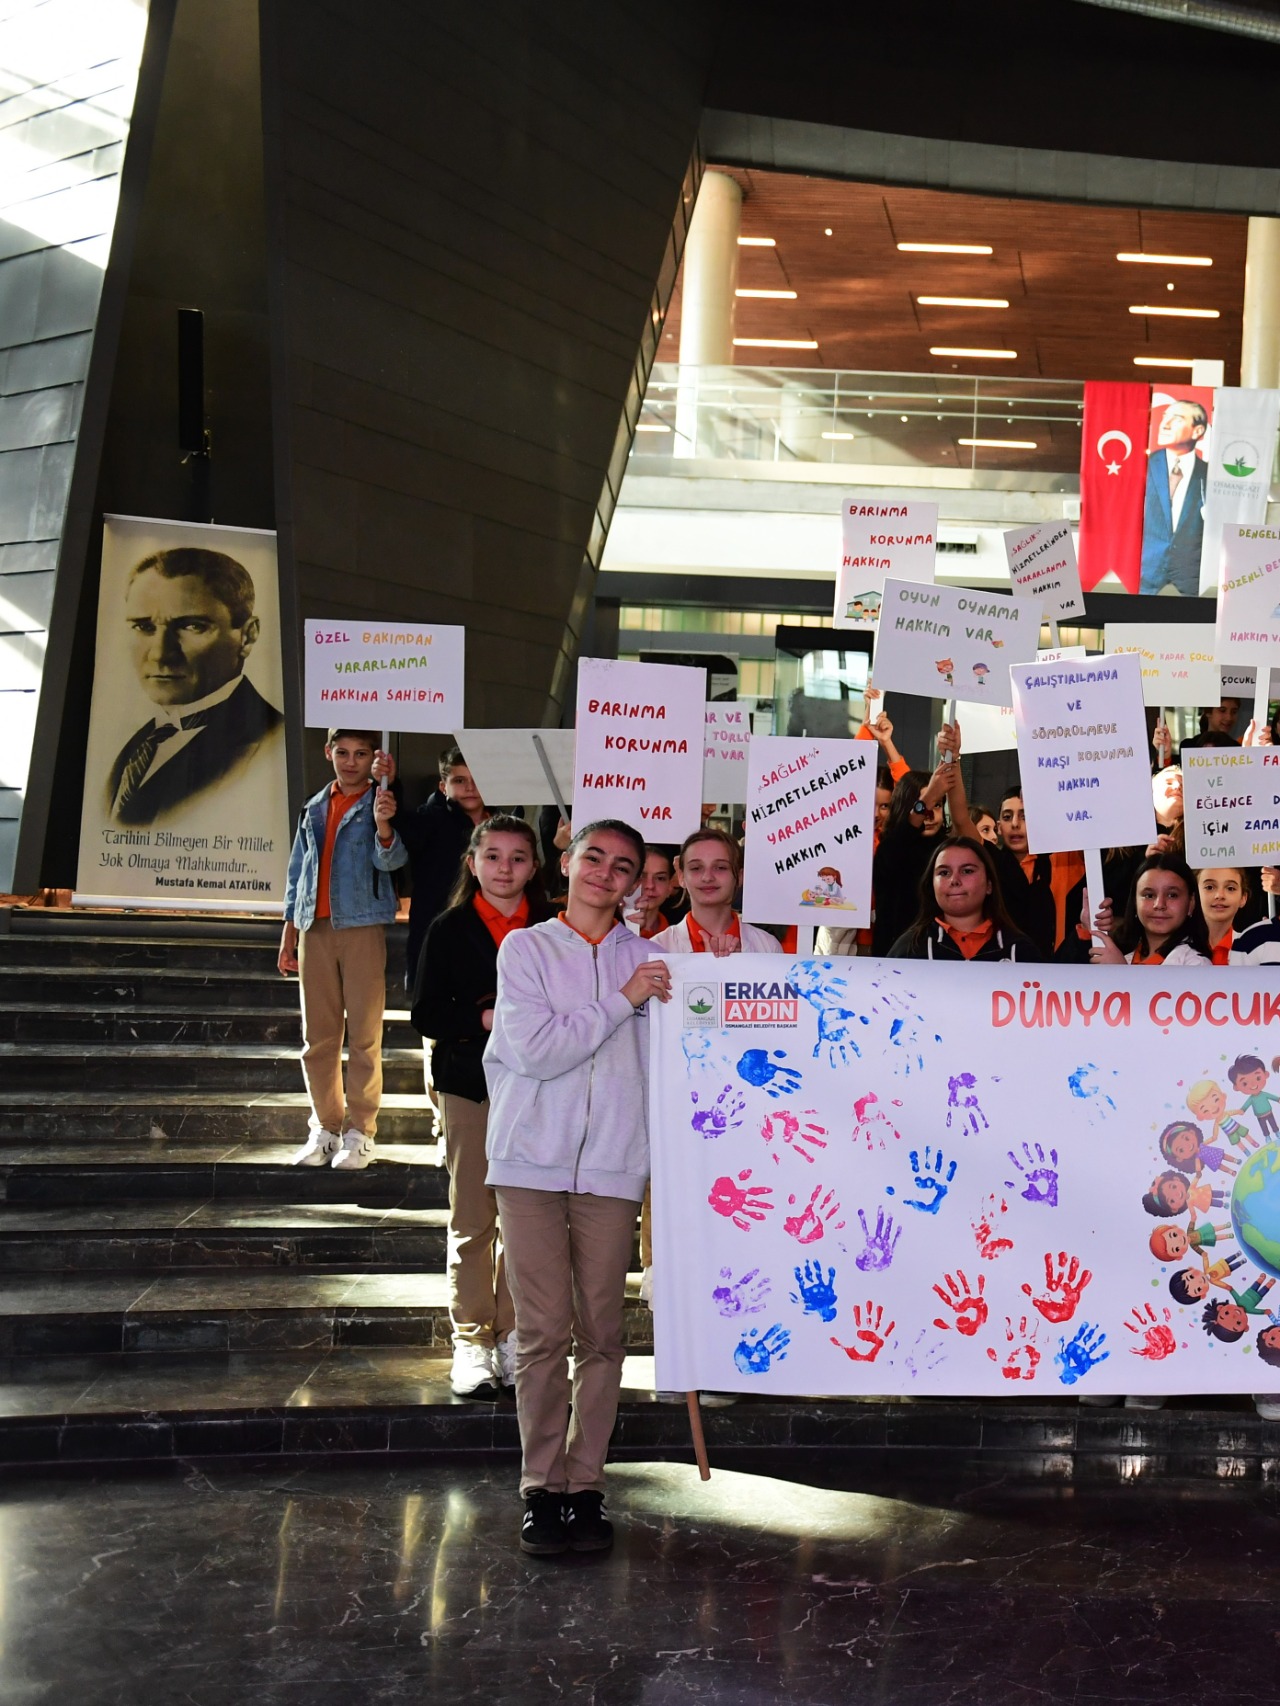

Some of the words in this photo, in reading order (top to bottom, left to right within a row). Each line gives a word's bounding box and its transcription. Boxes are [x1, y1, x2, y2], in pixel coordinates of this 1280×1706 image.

[850, 506, 908, 517] BARINMA
[870, 534, 933, 545] KORUNMA
[1239, 529, 1280, 540] DENGELİ
[843, 556, 891, 568] HAKKIM
[1017, 560, 1067, 584] YARARLANMA
[1033, 582, 1060, 594] HAKKIM
[899, 590, 940, 607] OYUN
[958, 599, 1019, 621] OYNAMA
[1060, 600, 1075, 609] VAR
[895, 617, 950, 637] HAKKIM
[965, 627, 993, 642] VAR
[315, 631, 350, 644] ÖZEL
[362, 632, 432, 645] BAKIMDAN
[1230, 632, 1268, 642] HAKKIM
[335, 656, 427, 673] YARARLANMA
[1190, 653, 1214, 662] ÇOCU
[1025, 670, 1118, 689] ÇALIŞTIRILMAYA
[1221, 676, 1256, 685] ÇOCUKL
[321, 689, 378, 702] HAKKINA
[387, 688, 444, 703] SAHİBİM
[588, 700, 666, 719] BARINMA
[1067, 700, 1082, 711] VE
[726, 711, 741, 723] VE
[605, 736, 687, 753] KORUNMA
[721, 750, 744, 760] VAR
[1038, 756, 1070, 769] KARŞI
[1078, 747, 1133, 761] KORUNMA
[1189, 755, 1253, 768] KÜLTÜREL
[762, 755, 808, 788] SAĞLIK
[583, 773, 646, 790] HAKKIM
[1058, 777, 1100, 791] HAKKIM
[1208, 777, 1223, 788] VE
[752, 756, 866, 822] HİZMETLERİNDEN
[1196, 796, 1252, 809] EĞLENCE
[640, 806, 672, 820] VAR
[767, 792, 858, 844] YARARLANMA
[1066, 811, 1092, 821] VAR.
[1202, 820, 1228, 836] İÇİN
[101, 830, 151, 846] Tarihini
[154, 832, 208, 851] Bilmeyen
[212, 836, 233, 849] Bir
[237, 836, 274, 852] Millet
[775, 843, 826, 874] HAKKIM
[834, 824, 862, 844] VAR
[1200, 846, 1235, 857] OLMA
[99, 853, 123, 868] Yok
[128, 854, 170, 872] Olmaya
[155, 876, 194, 888] Mustafa
[197, 879, 227, 889] Kemal
[229, 880, 272, 891] ATATÜRK
[724, 982, 799, 999] ERKAN
[728, 1002, 794, 1020] AYDIN
